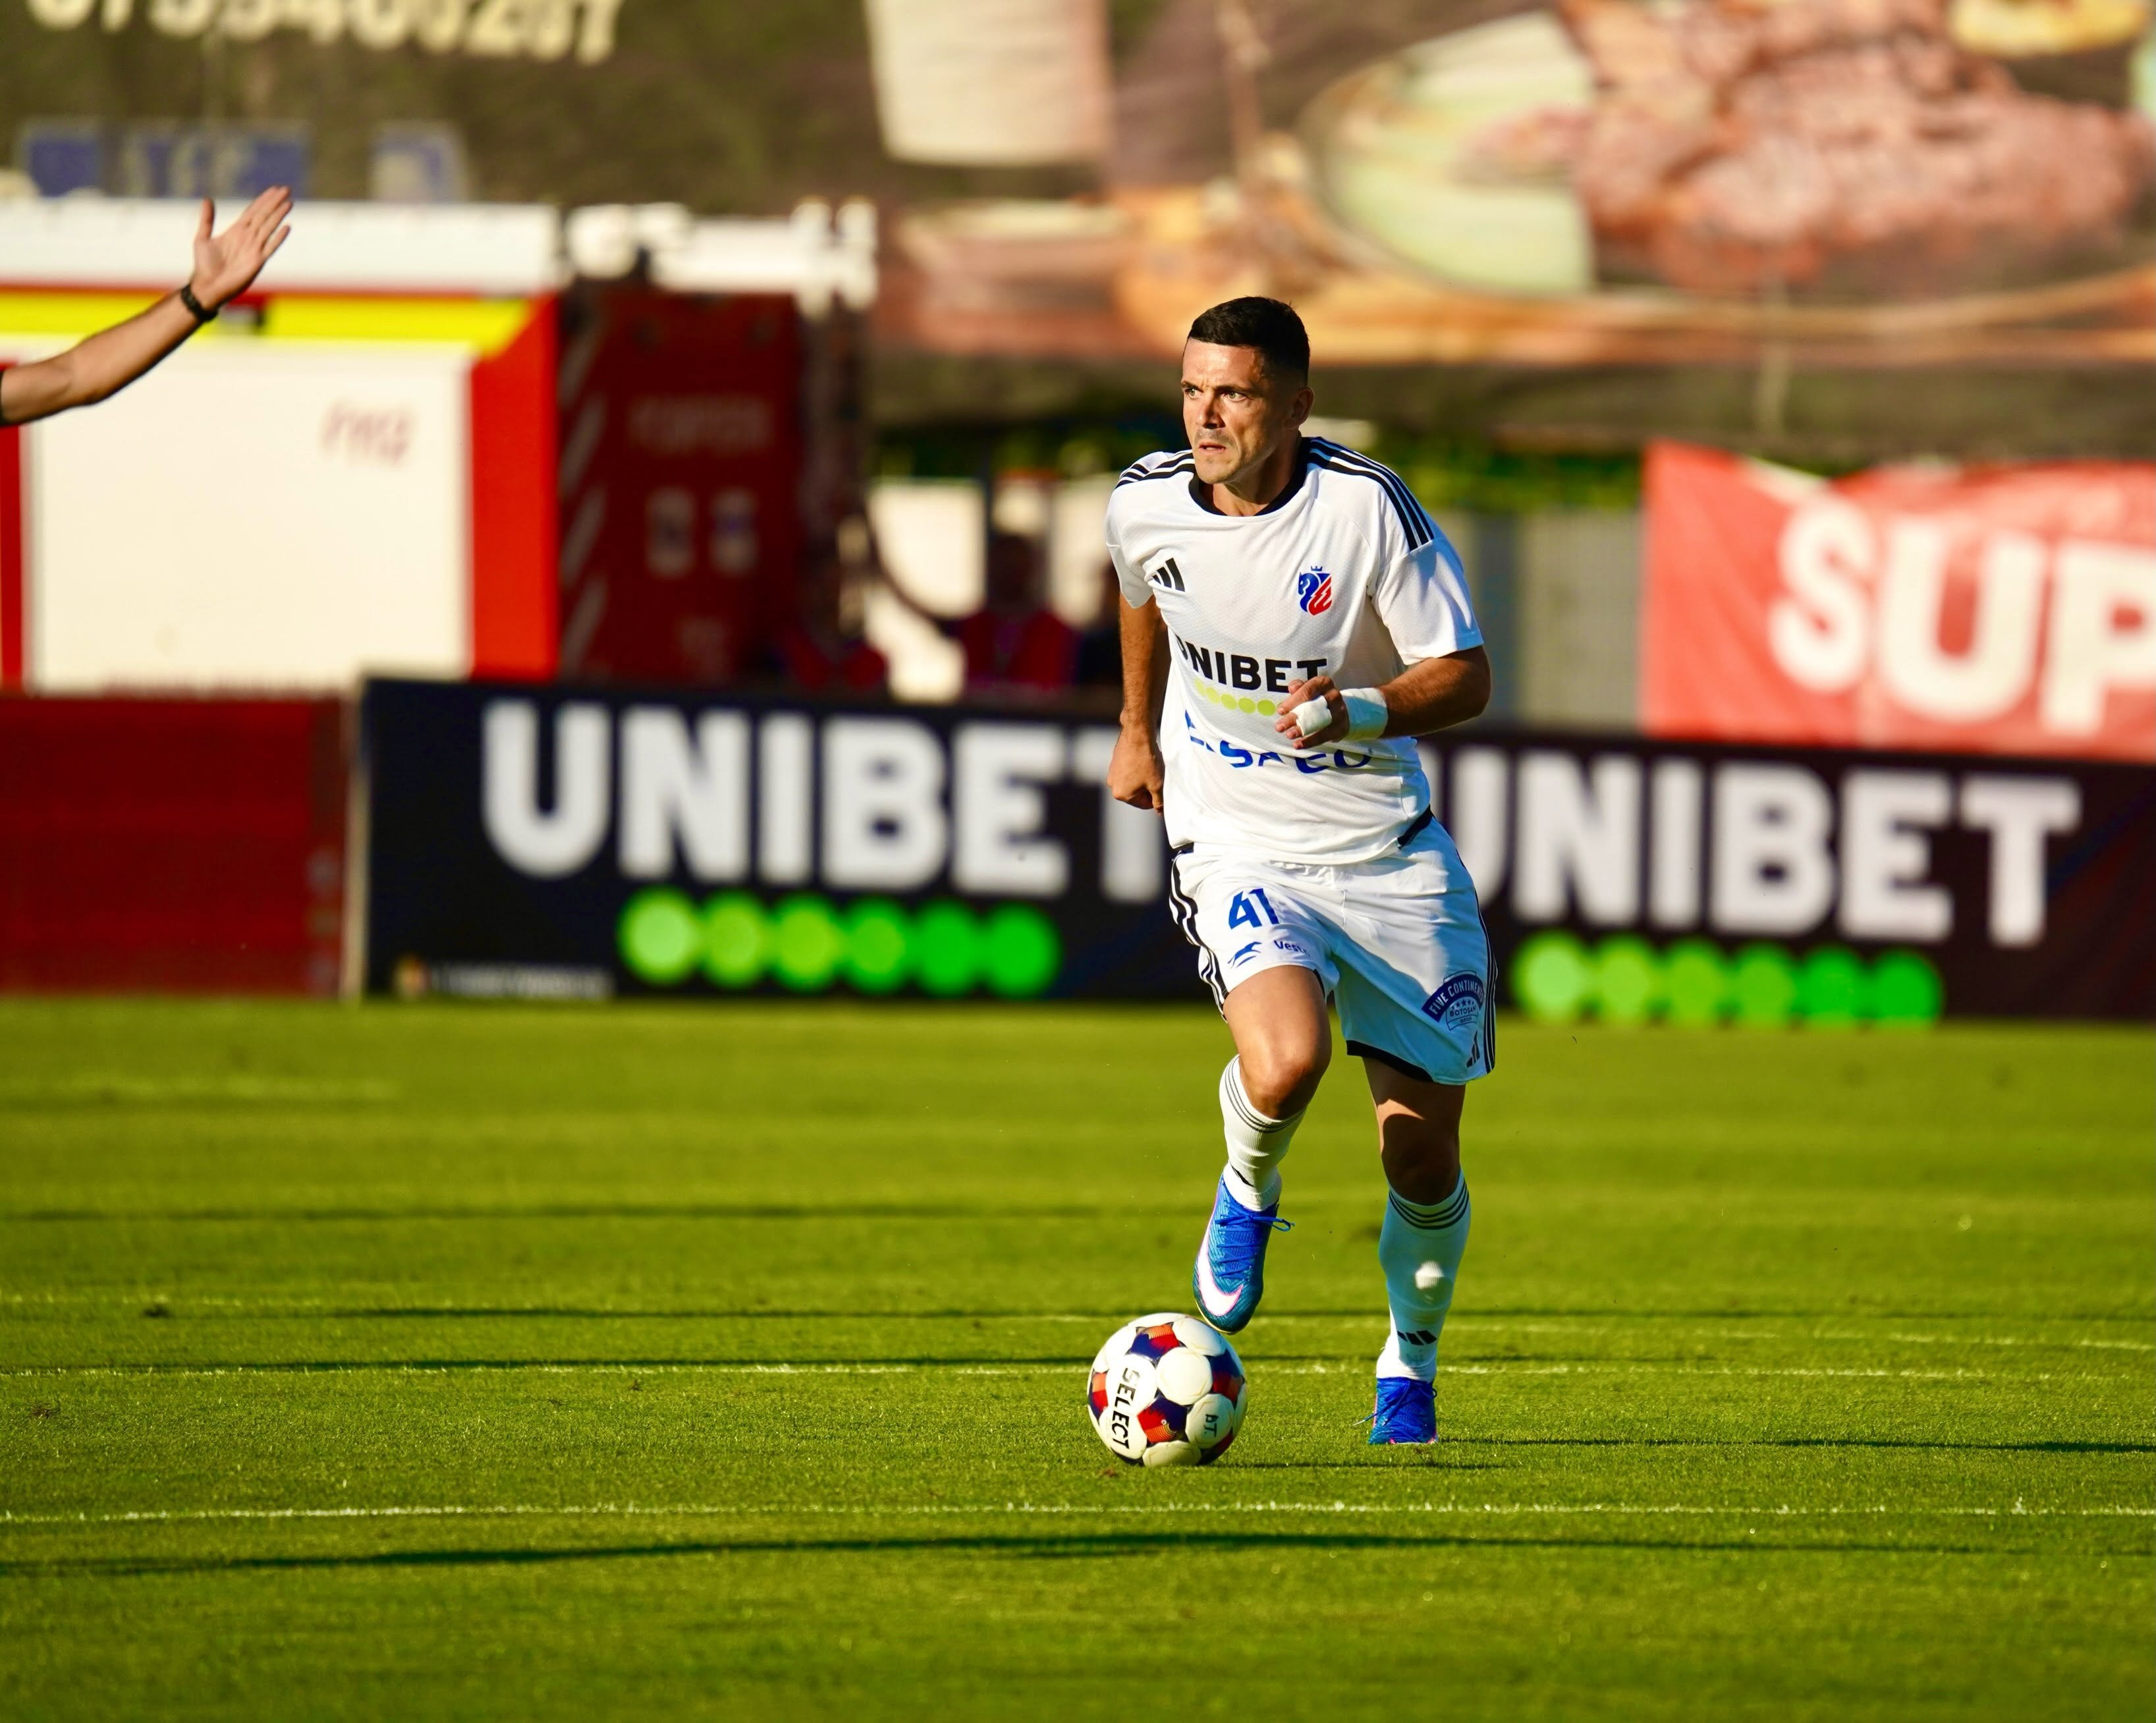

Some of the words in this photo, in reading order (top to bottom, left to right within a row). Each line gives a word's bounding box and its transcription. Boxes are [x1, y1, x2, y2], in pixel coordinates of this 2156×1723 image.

[1767, 493, 2156, 735] SUP
[1229, 888, 1280, 930] 41
[1428, 992, 1449, 1015] FIVE
[1111, 1367, 1140, 1450] SELECT
